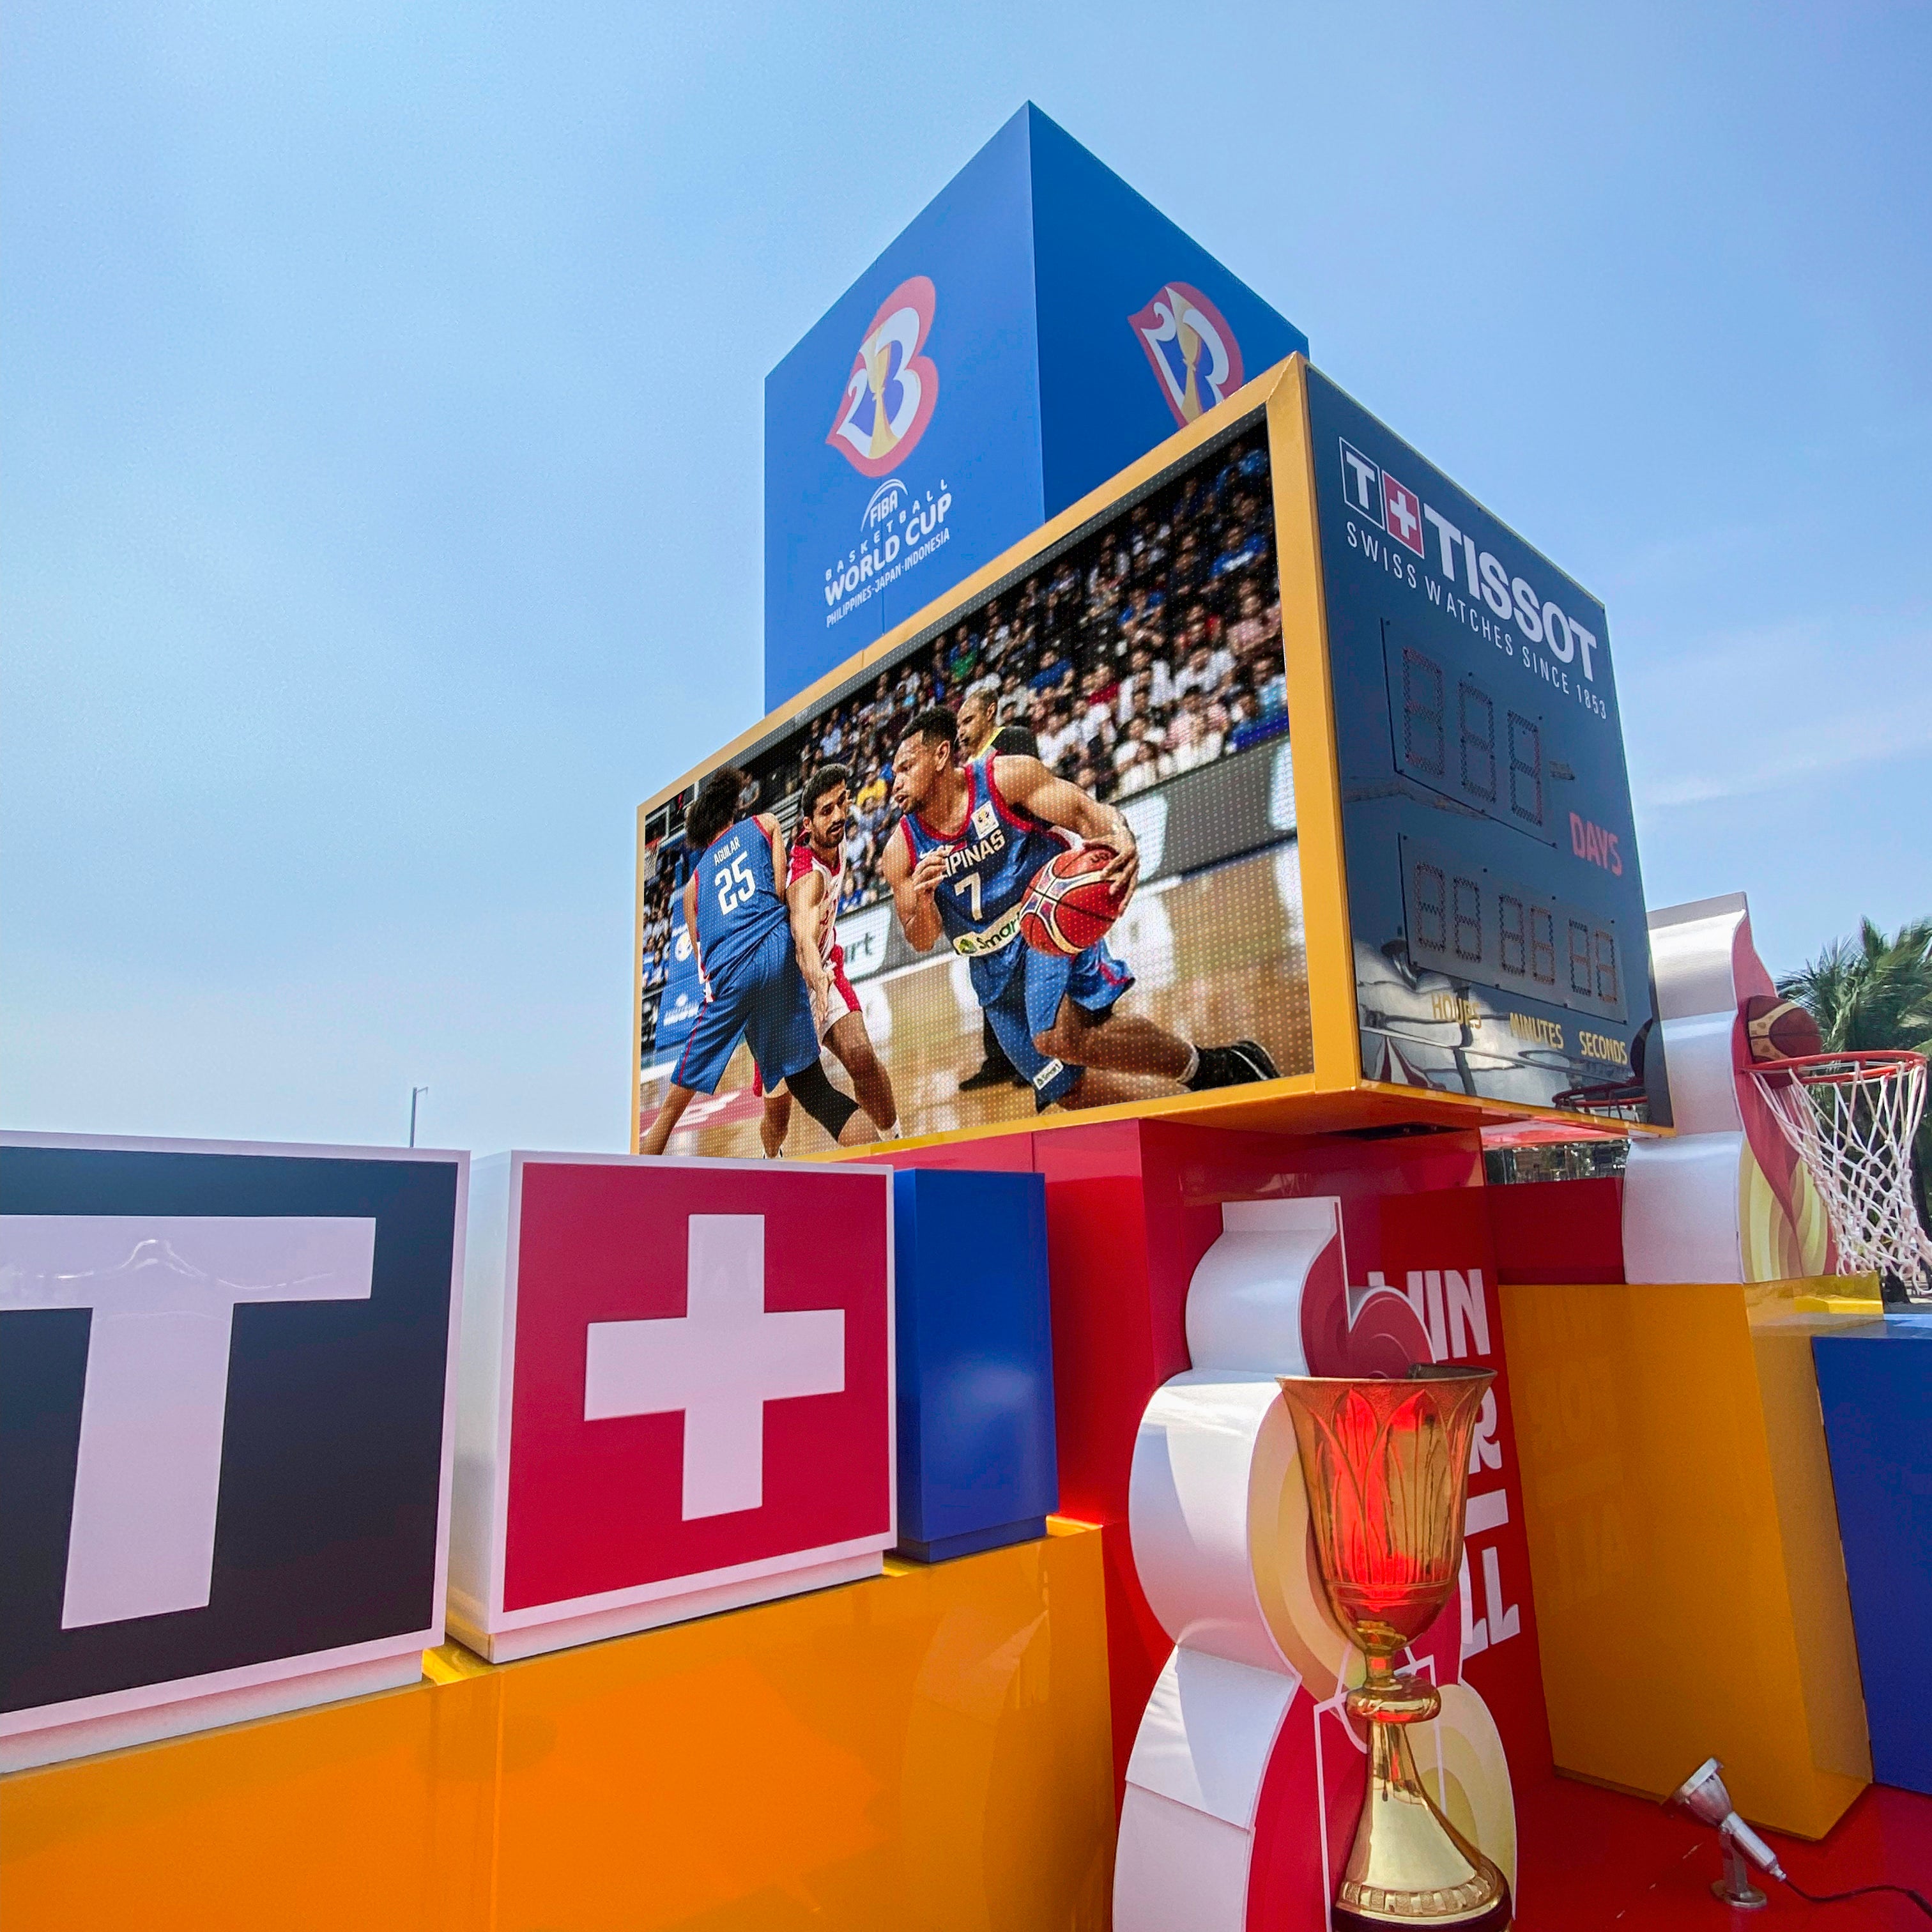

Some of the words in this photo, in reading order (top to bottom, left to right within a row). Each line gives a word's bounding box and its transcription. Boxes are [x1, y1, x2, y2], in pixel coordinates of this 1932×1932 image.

[825, 479, 947, 581] BASKETBALL
[870, 490, 898, 528] FIBA
[825, 535, 900, 606] WORLD
[905, 493, 952, 546] CUP
[1347, 521, 1417, 588] SWISS
[1425, 576, 1514, 656] WATCHES
[1522, 646, 1570, 694] SINCE
[1576, 684, 1607, 720] 1853
[1423, 503, 1597, 682] TISSOT
[714, 836, 740, 866] AGUILAR
[1569, 812, 1623, 877] DAYS
[714, 850, 756, 916] 25
[954, 871, 983, 921] 7
[1431, 993, 1482, 1029] HOURS
[1510, 1012, 1564, 1049] MINUTES
[1579, 1031, 1629, 1065] SECONDS
[0, 1215, 376, 1630] T
